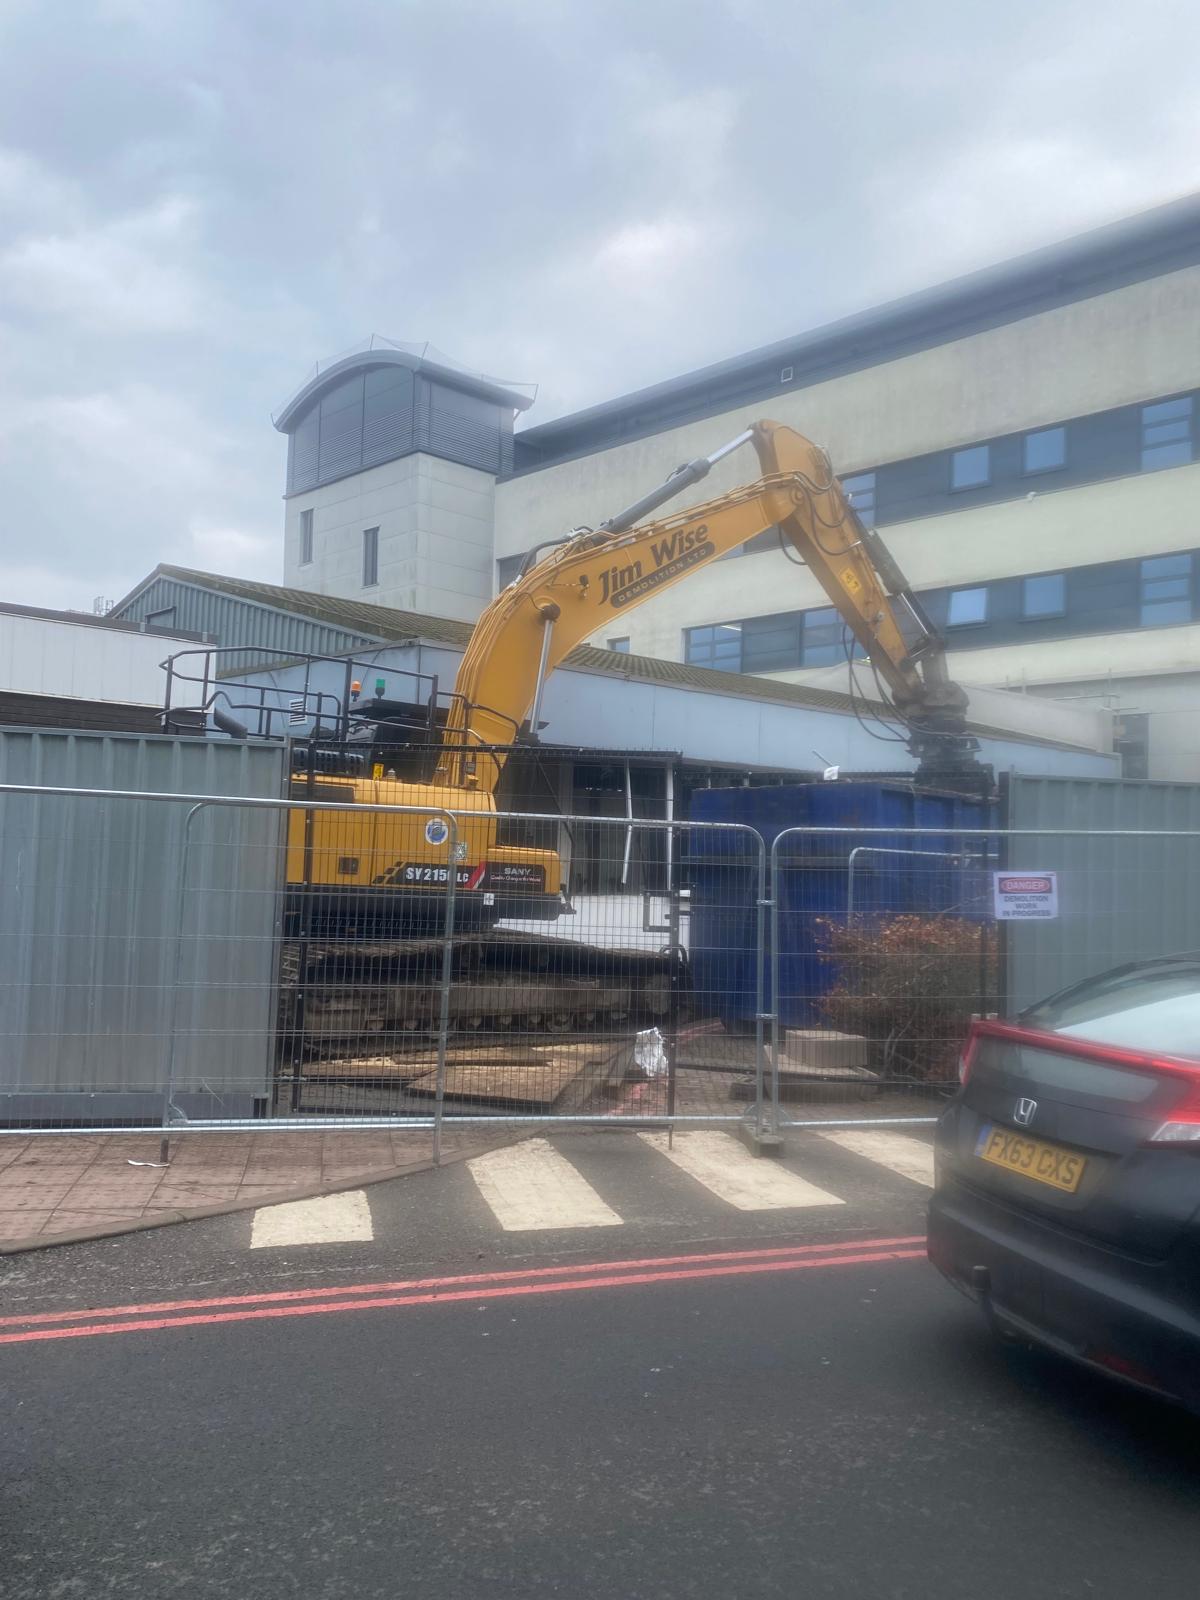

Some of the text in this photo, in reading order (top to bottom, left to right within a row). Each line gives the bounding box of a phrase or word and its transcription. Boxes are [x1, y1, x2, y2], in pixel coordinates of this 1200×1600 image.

[598, 524, 709, 606] Jim Wise
[618, 548, 706, 602] DEMOLITION LTD
[504, 867, 531, 875] SANY
[1007, 881, 1046, 890] DANGER
[987, 1131, 1080, 1184] FX63 CXS
